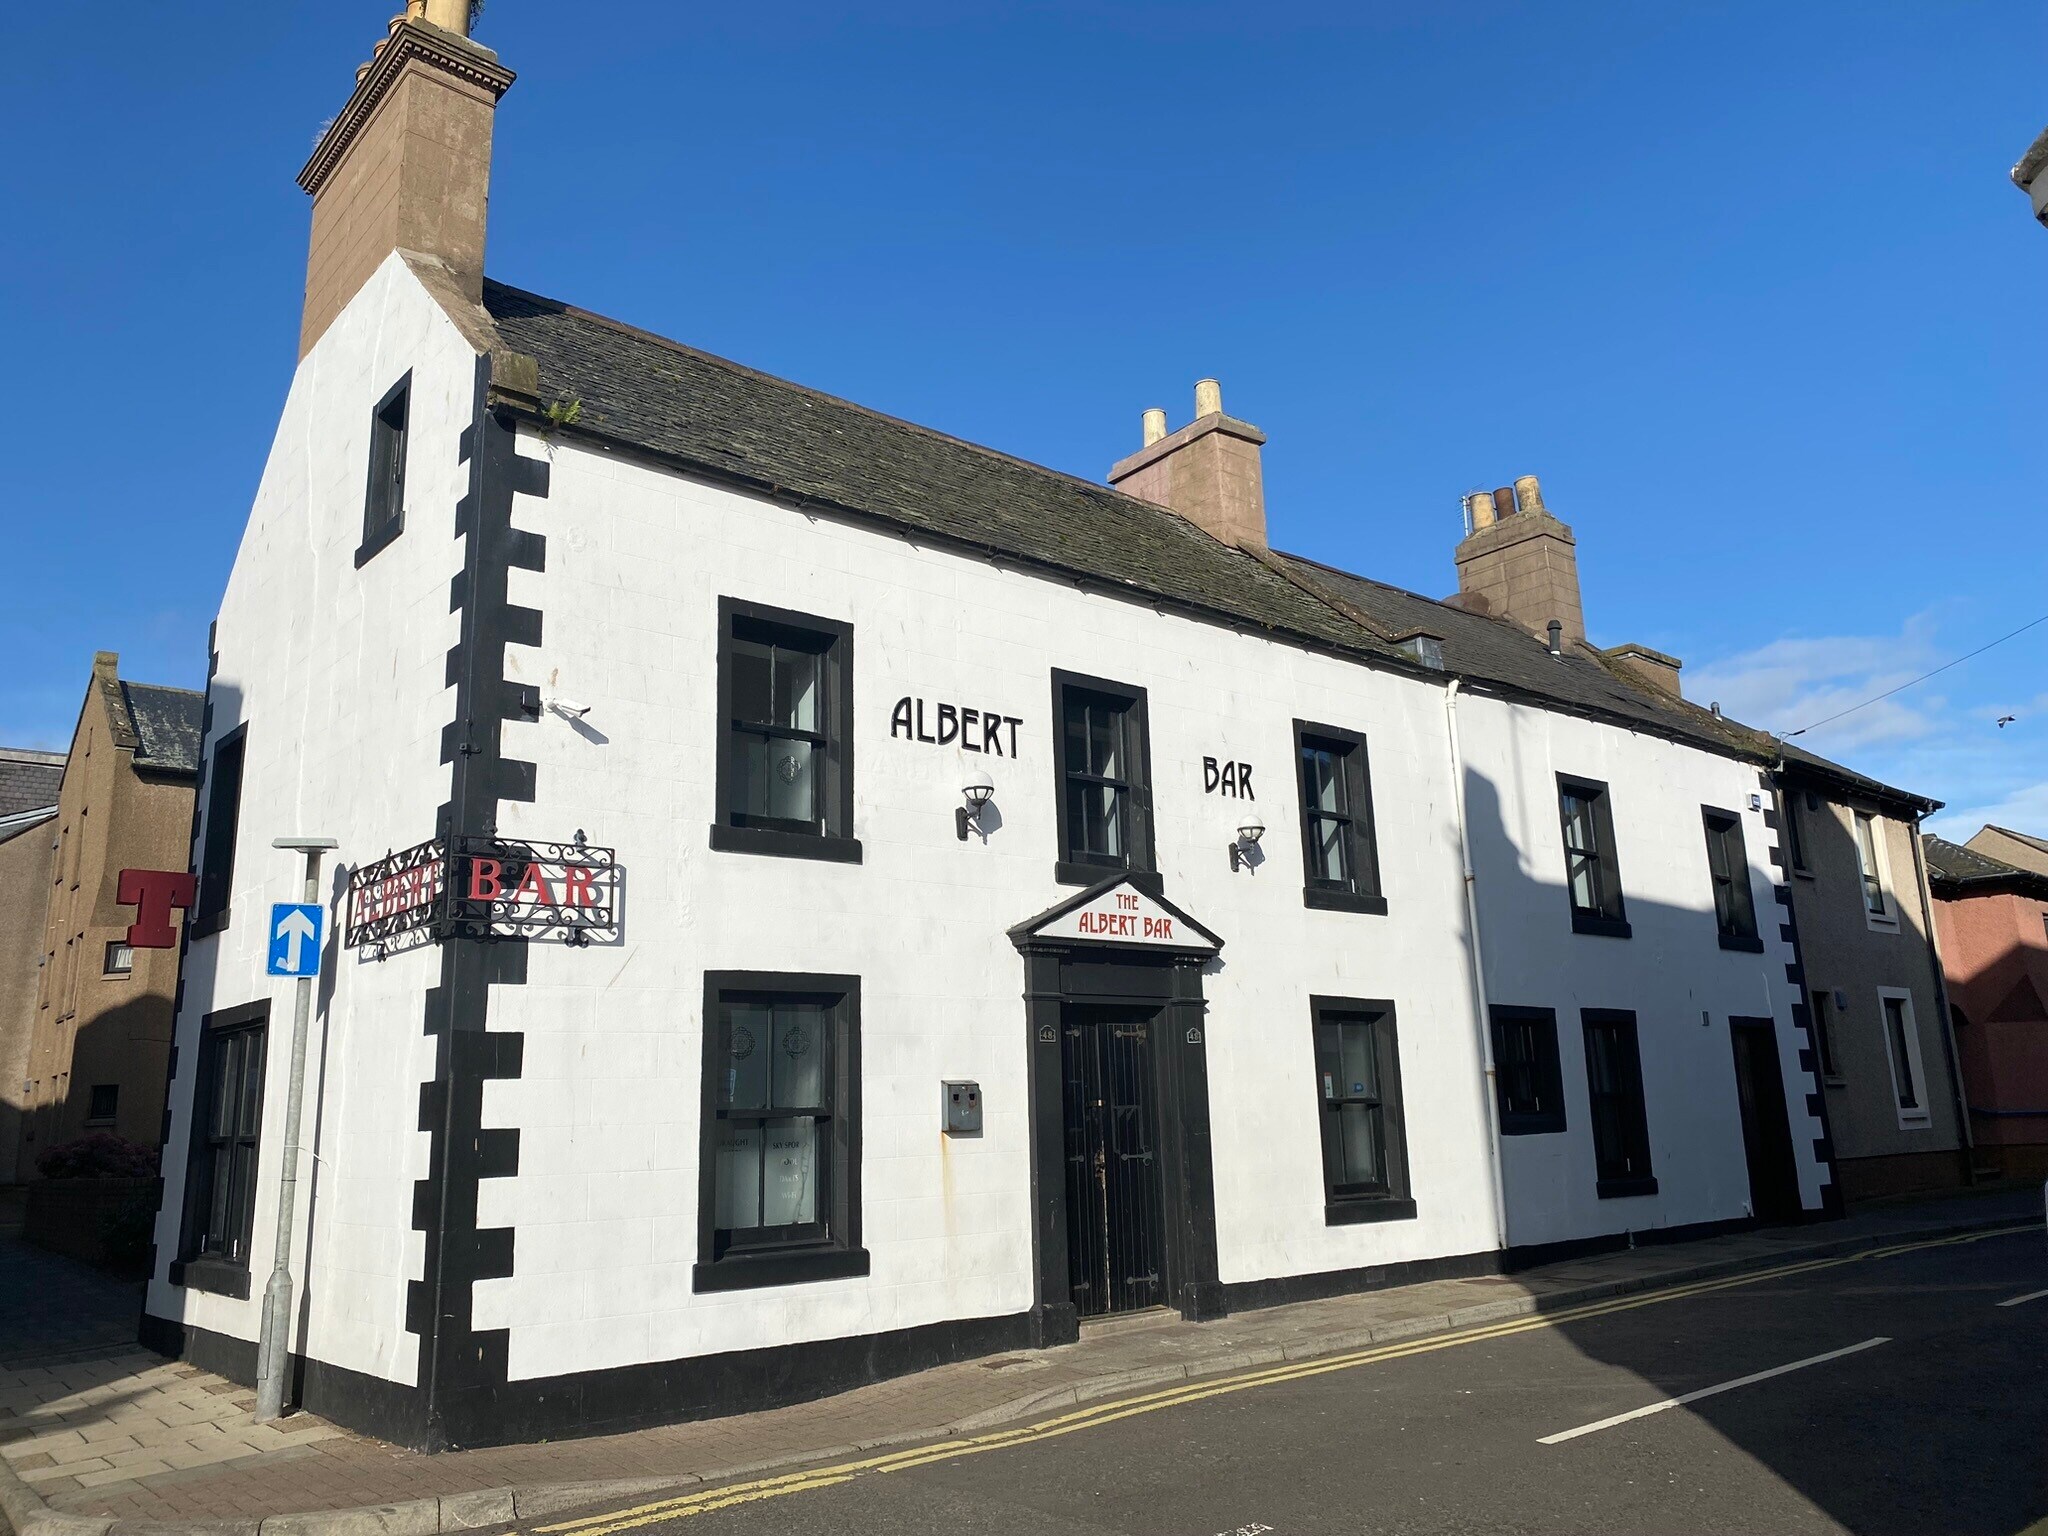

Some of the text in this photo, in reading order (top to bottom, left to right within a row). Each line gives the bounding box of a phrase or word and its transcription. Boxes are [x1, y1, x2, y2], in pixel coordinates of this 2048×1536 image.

[890, 697, 1255, 801] ALBERT BAR
[354, 857, 594, 927] ALBERT BAR
[1116, 894, 1139, 910] THE
[116, 869, 198, 949] T
[1078, 912, 1173, 939] ALBERT BAR
[1042, 1030, 1053, 1040] 48
[1189, 1032, 1199, 1041] 48
[773, 1141, 783, 1150] SKY
